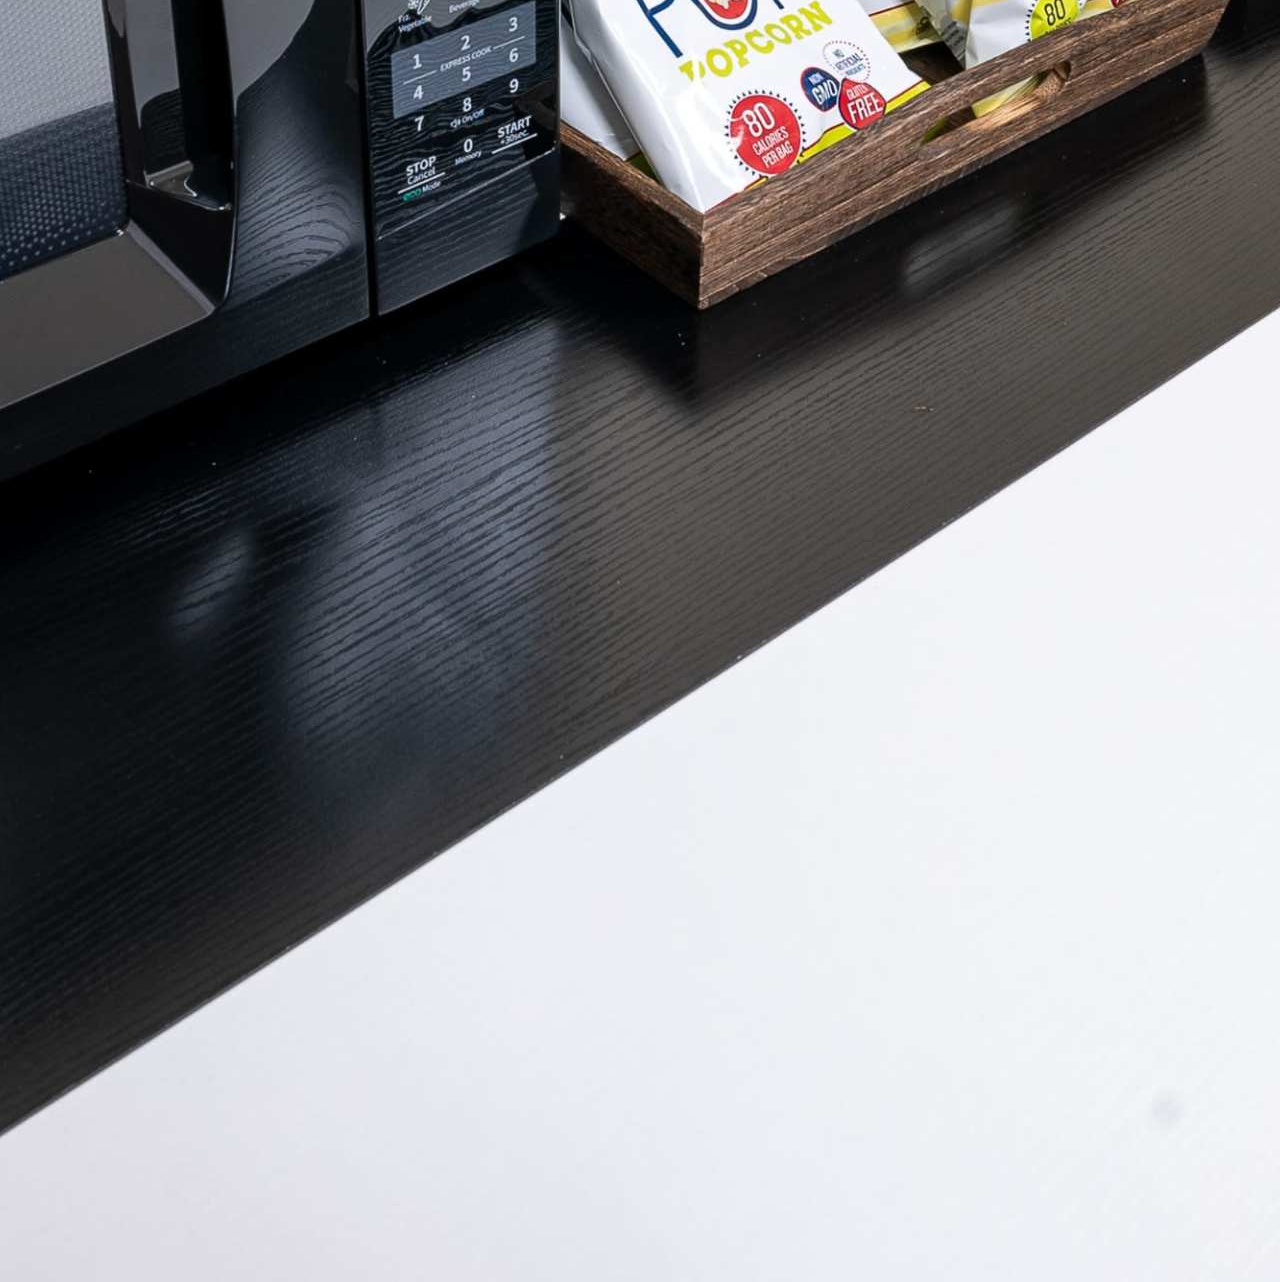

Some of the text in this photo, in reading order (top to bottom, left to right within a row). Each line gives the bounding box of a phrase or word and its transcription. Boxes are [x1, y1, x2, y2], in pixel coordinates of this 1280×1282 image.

[508, 16, 518, 33] 3
[460, 34, 471, 51] 2
[678, 0, 833, 84] POPCORN
[412, 53, 423, 70] 1
[439, 45, 492, 72] EXPRESS COOK
[508, 47, 519, 63] 6
[461, 66, 471, 82] 5
[412, 84, 424, 101] 4
[508, 77, 519, 94] 9
[811, 79, 838, 106] GMO
[846, 84, 869, 100] GLUTEN
[462, 97, 472, 113] 8
[847, 91, 884, 124] FREE
[414, 115, 425, 132] 7
[497, 115, 532, 139] START
[742, 102, 776, 138] 80
[463, 138, 474, 153] 0
[752, 125, 790, 156] CALORIES
[454, 149, 483, 166] Memory
[761, 140, 794, 169] PER BAG
[406, 155, 437, 177] STOP
[407, 166, 437, 186] Cancel
[421, 180, 441, 193] Mode
